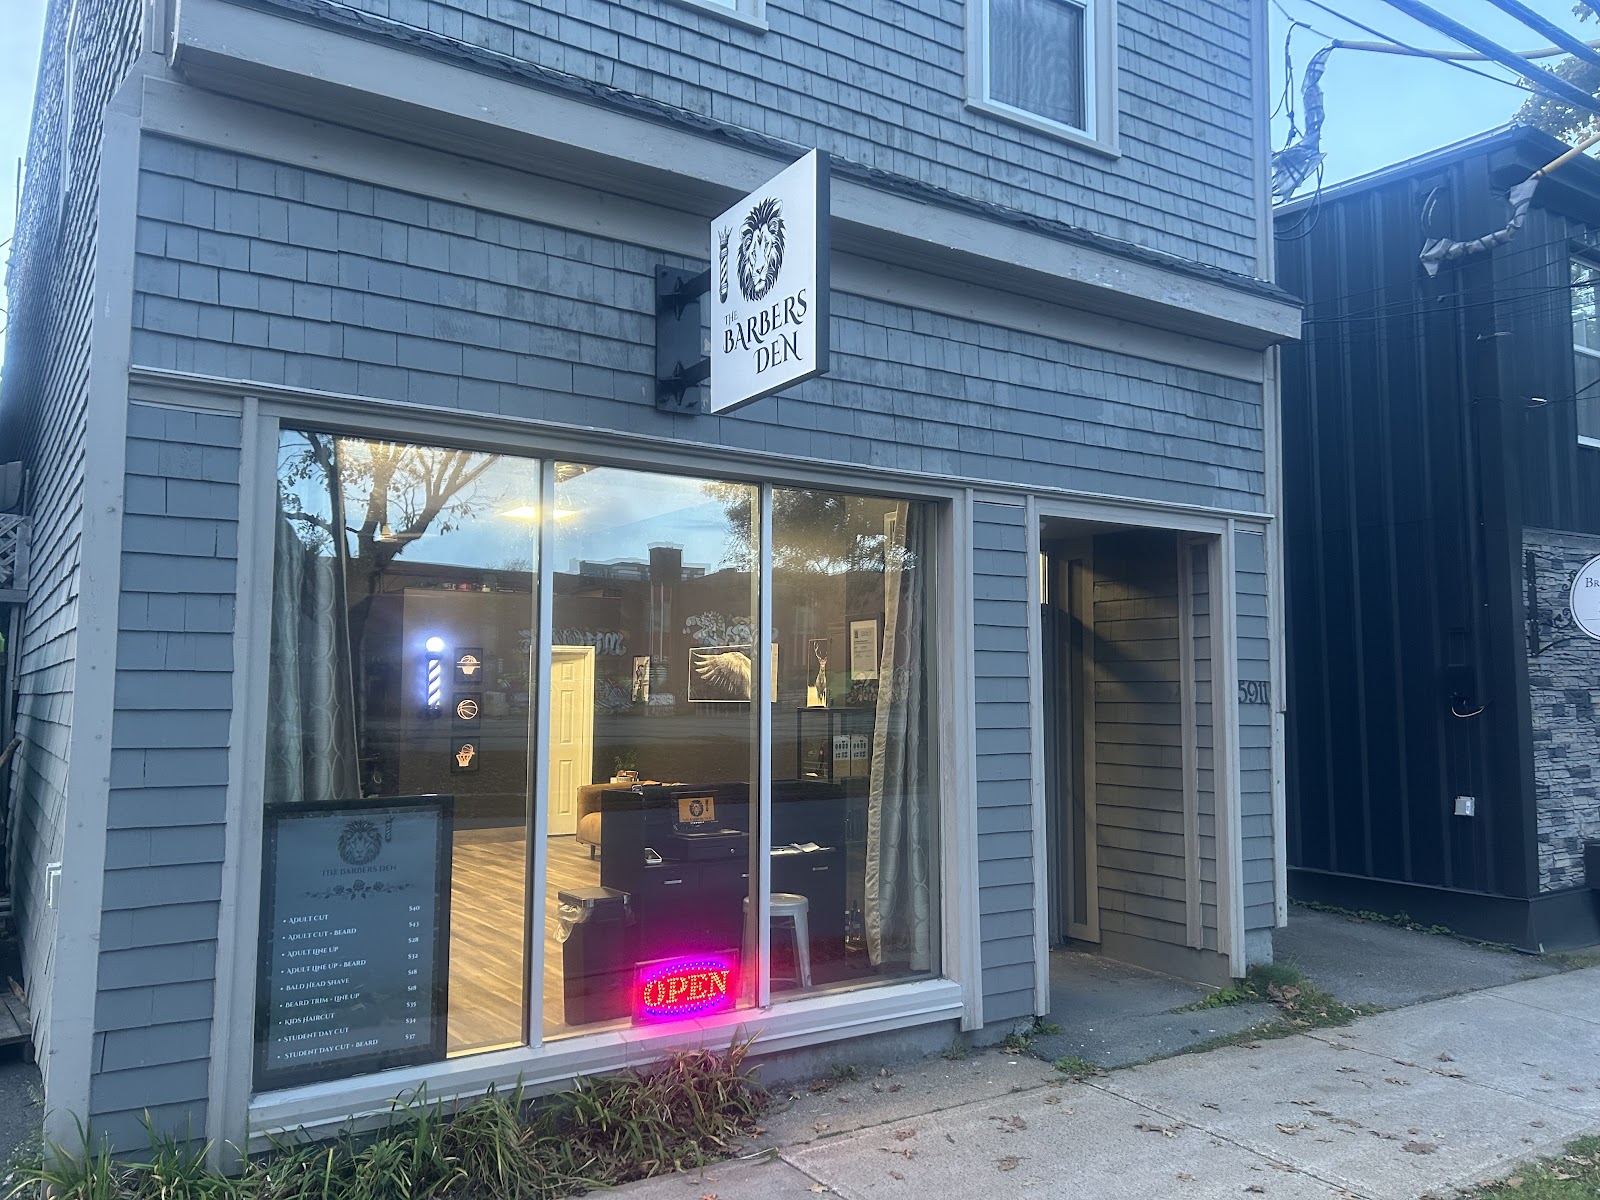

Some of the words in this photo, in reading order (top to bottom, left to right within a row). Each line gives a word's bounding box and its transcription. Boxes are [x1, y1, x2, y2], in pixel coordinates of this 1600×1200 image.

[723, 288, 808, 354] BARBERS
[724, 310, 738, 326] THE
[753, 330, 804, 374] DEN
[1238, 680, 1268, 704] 5911
[322, 868, 338, 876] THE
[340, 865, 378, 875] BARBERS
[288, 916, 312, 924] ADULT
[288, 932, 311, 940] ADULT
[334, 928, 357, 936] BEARD
[287, 949, 311, 957] ADULT
[312, 947, 327, 955] LINE
[286, 966, 310, 974] ADULT
[312, 964, 326, 972] LINE
[306, 981, 326, 989] HEAD
[327, 978, 350, 986] SHAVE
[644, 970, 730, 1007] OPEN
[285, 1000, 309, 1008] BEARD
[284, 1017, 302, 1025] KIDS
[302, 1013, 335, 1023] HAIRCUT
[284, 1033, 317, 1042] STUDENT
[285, 1049, 318, 1059] STUDENT
